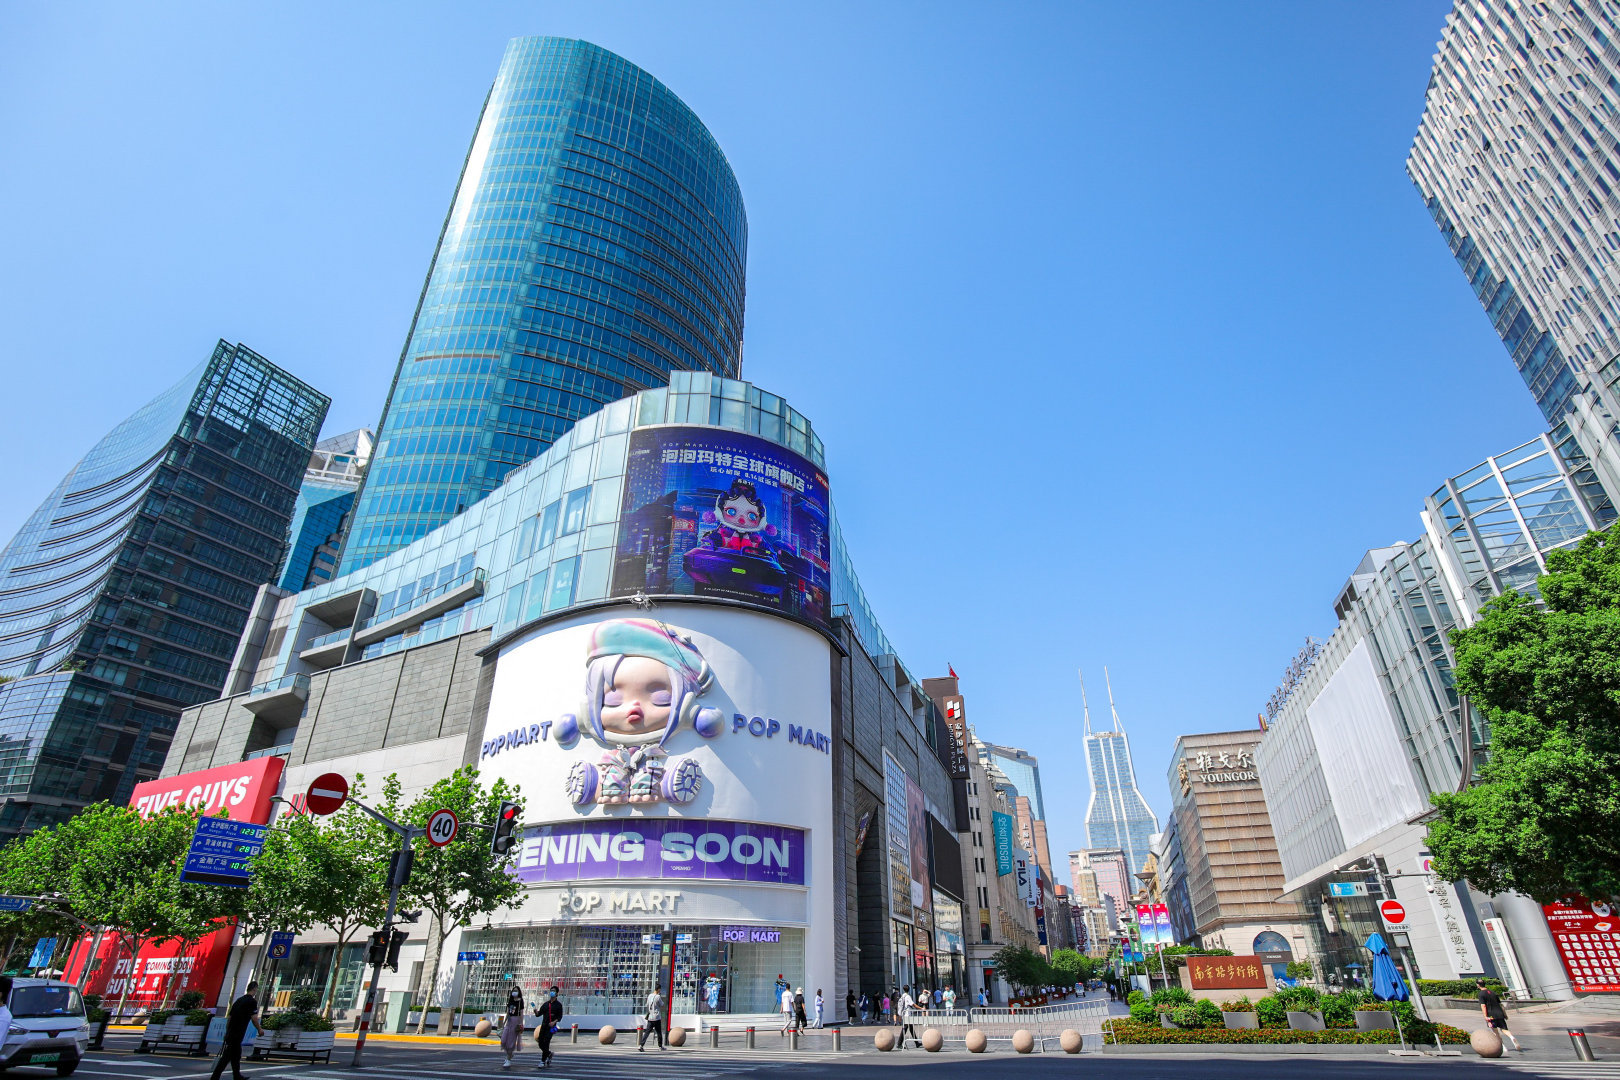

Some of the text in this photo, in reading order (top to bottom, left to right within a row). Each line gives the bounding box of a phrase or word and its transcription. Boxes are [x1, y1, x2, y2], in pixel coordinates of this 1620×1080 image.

[661, 449, 805, 492] 泡泡玛特全球旗舰店
[481, 720, 552, 761] POP MART
[732, 713, 832, 755] POP MART
[1196, 748, 1252, 773] 雅戈尔
[1200, 772, 1258, 784] YOUNGOR
[186, 776, 250, 812] GUYS
[432, 818, 453, 838] 40
[660, 832, 790, 868] SOON
[1016, 860, 1028, 887] FILA
[557, 891, 681, 914] POP MART
[723, 930, 780, 942] POP MART
[146, 960, 172, 970] COMING
[1194, 964, 1258, 984] 南京路步行街
